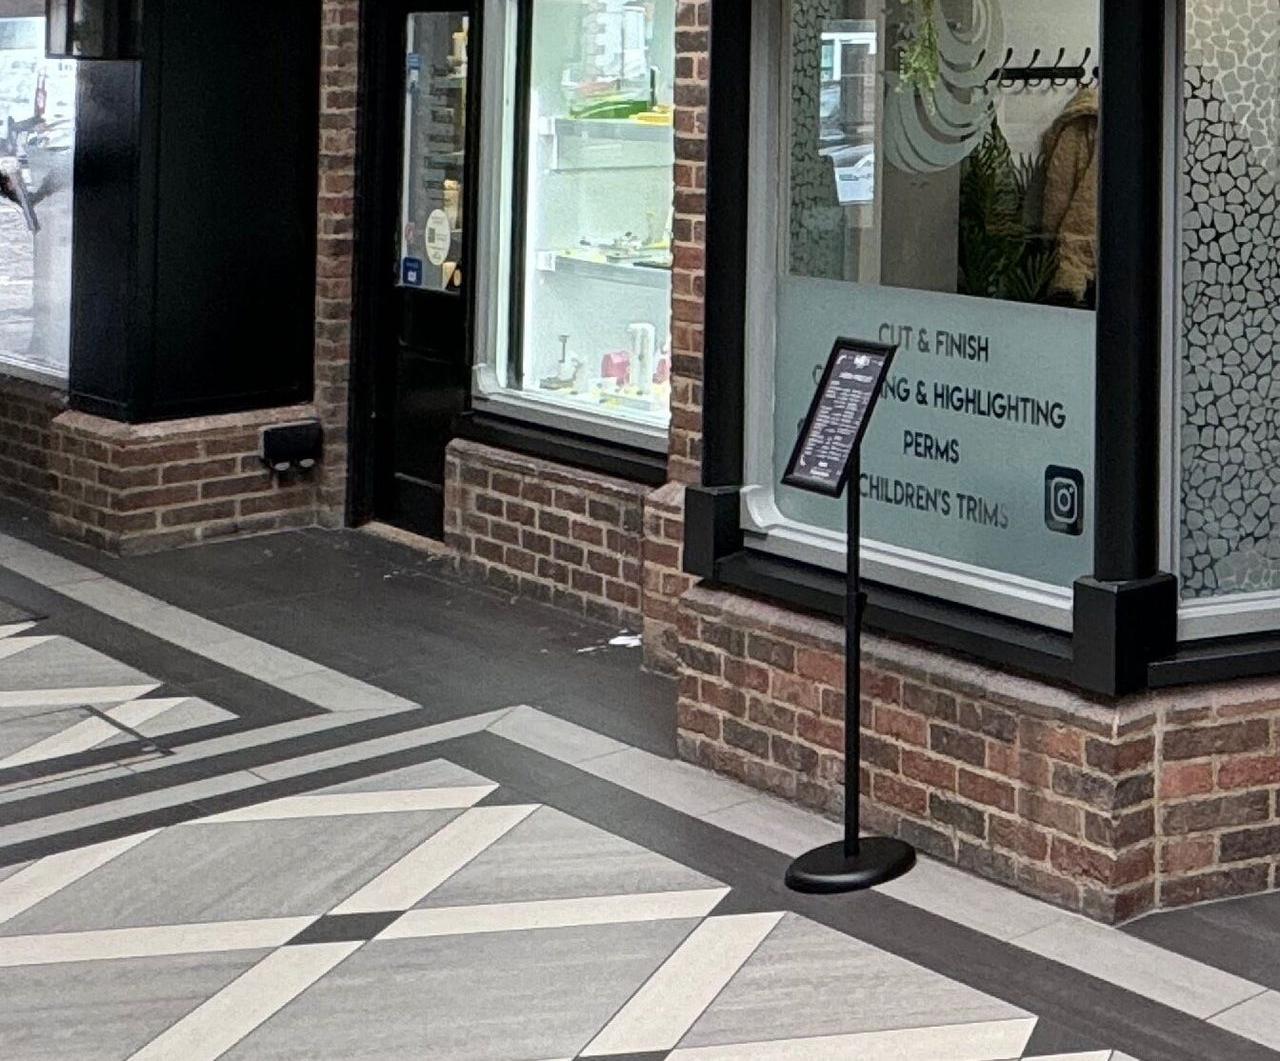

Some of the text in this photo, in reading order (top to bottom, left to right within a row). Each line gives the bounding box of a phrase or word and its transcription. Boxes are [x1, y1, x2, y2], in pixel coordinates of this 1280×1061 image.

[878, 323, 989, 362] CUT & FINISH
[915, 380, 928, 405] &
[933, 383, 1067, 429] HIGHLIGHTING
[903, 430, 960, 463] PERMS
[859, 473, 1009, 530] CHILDREN'S TRIMS
